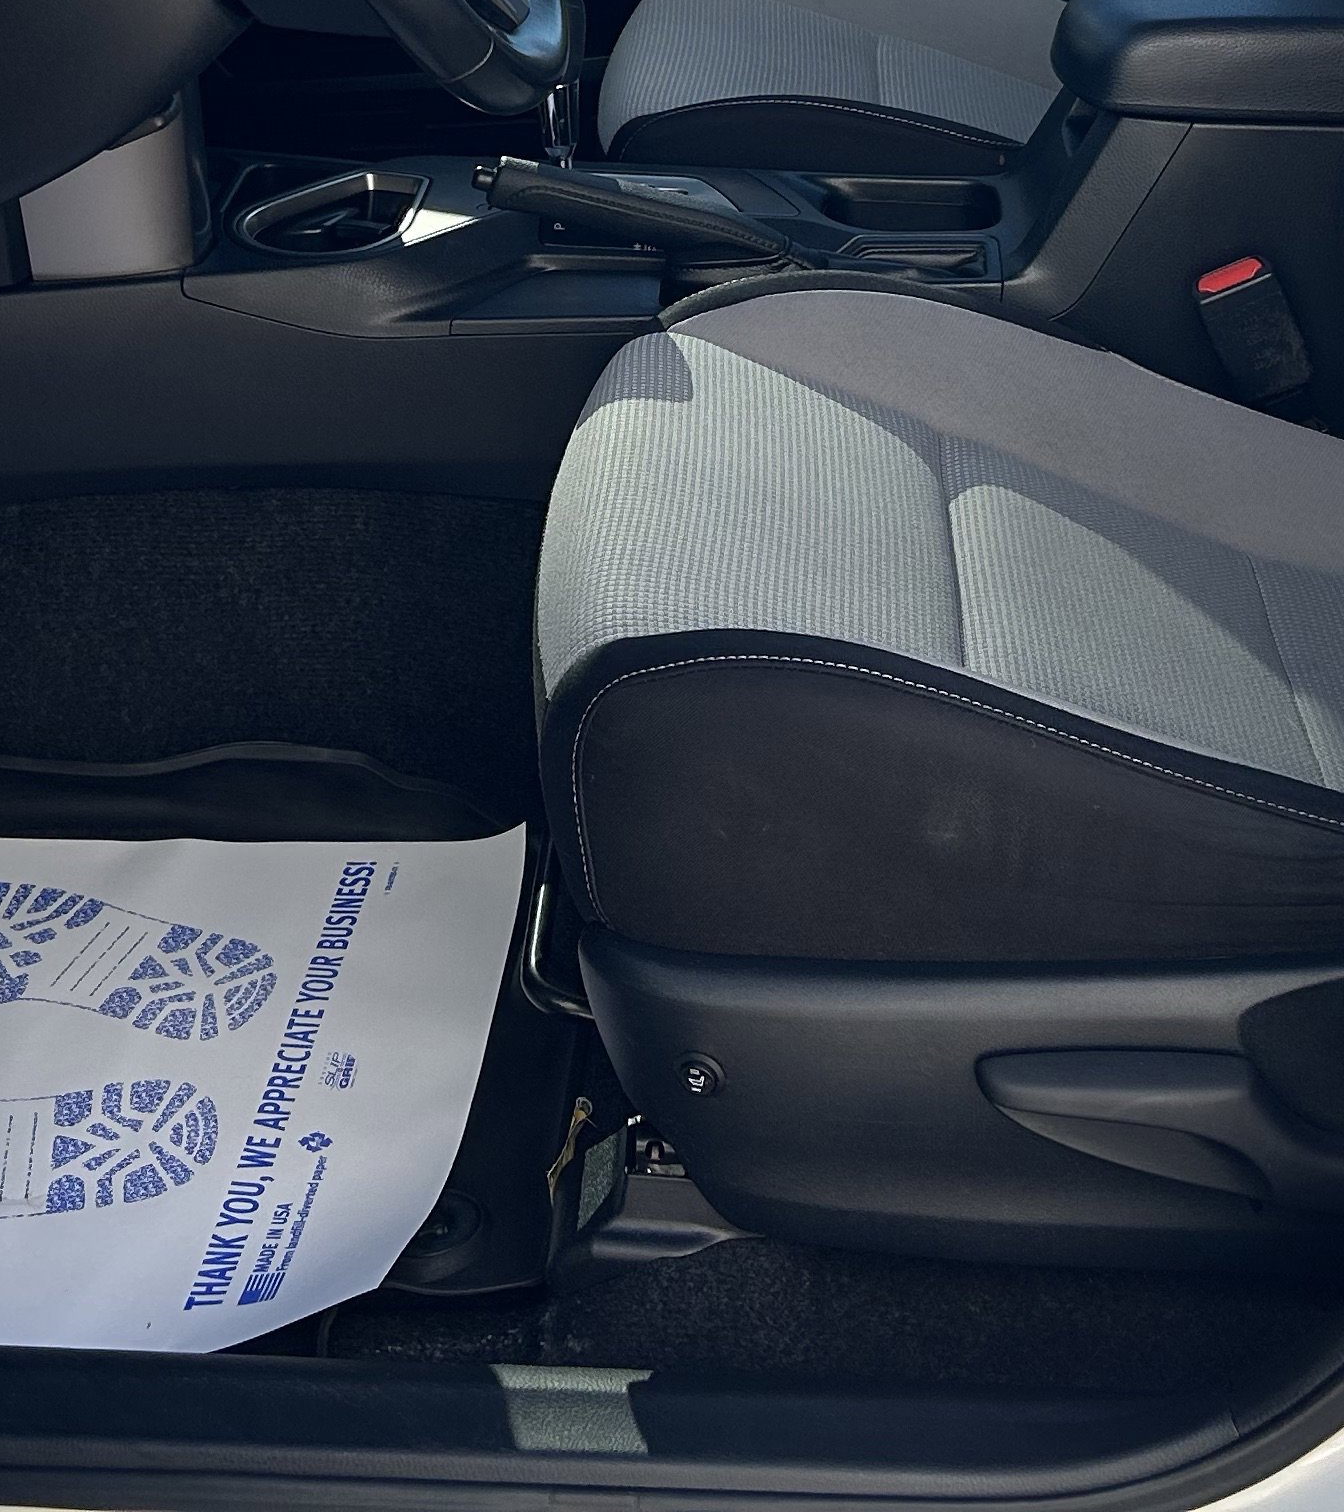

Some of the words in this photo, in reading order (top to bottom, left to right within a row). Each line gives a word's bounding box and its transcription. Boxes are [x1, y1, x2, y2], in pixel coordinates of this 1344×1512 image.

[316, 861, 378, 950] BUSINESS!
[295, 954, 345, 1003] YOUR
[252, 1008, 325, 1132] APPRECIATE
[324, 1051, 341, 1087] SLIP
[236, 1135, 282, 1169] WE
[312, 1155, 328, 1181] paper
[215, 1176, 275, 1228] YOU,
[270, 1202, 294, 1225] USA
[265, 1228, 284, 1239] IN
[183, 1233, 249, 1311] THANK
[252, 1243, 279, 1273] MADE
